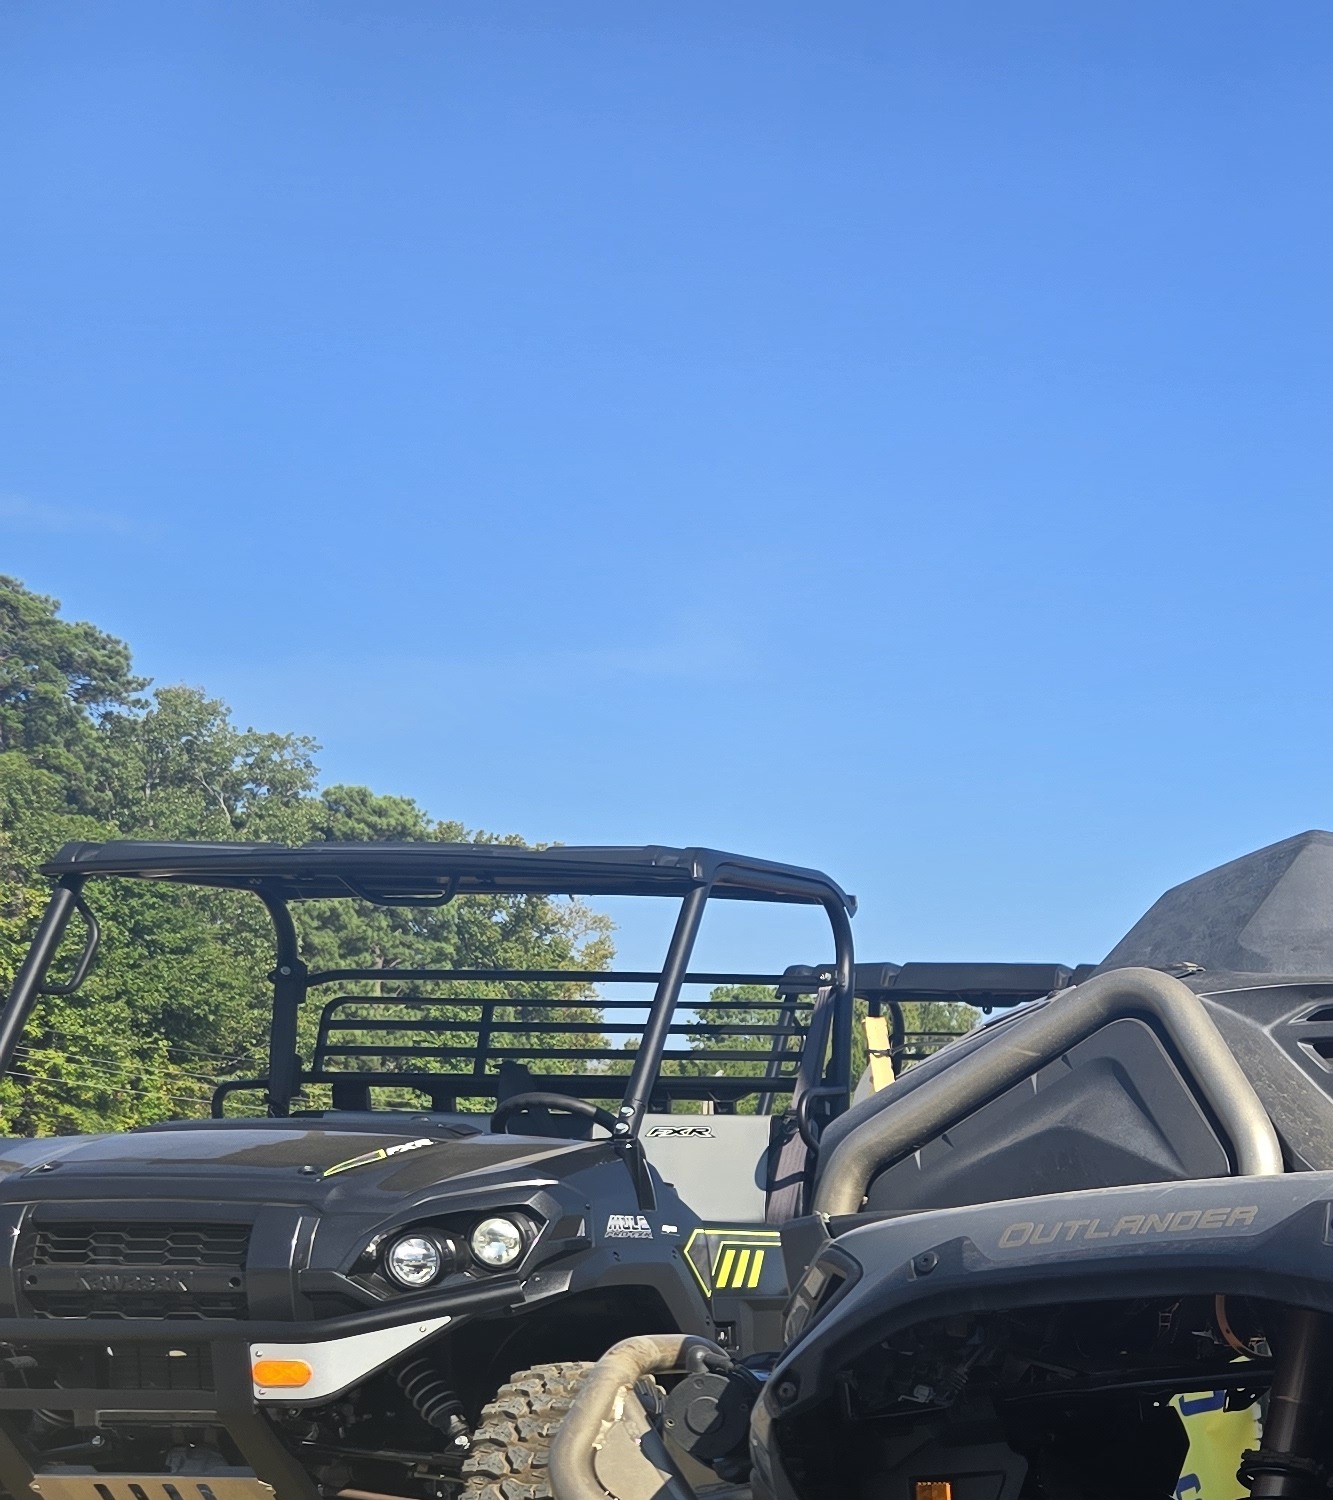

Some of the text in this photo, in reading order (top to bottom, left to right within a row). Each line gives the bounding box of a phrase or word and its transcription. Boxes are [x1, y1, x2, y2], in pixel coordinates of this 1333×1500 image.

[645, 1126, 716, 1138] FXR
[606, 1214, 651, 1232] MULE
[998, 1205, 1258, 1248] OUTLANDER
